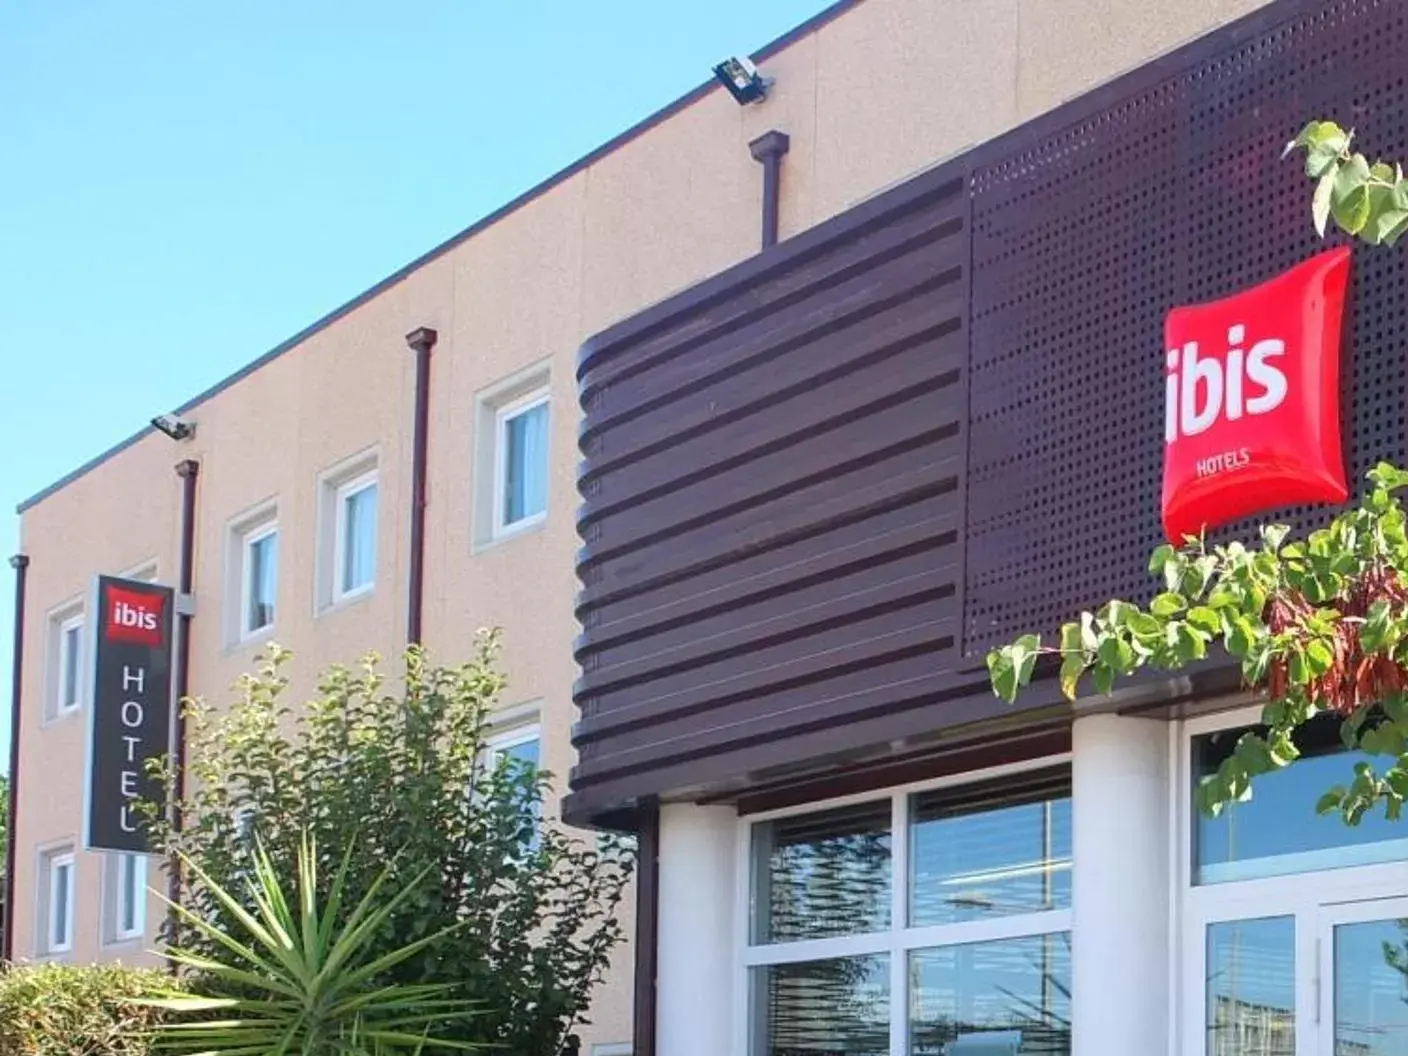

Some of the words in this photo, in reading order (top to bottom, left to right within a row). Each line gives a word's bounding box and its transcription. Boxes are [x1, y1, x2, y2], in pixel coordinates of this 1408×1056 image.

[1165, 324, 1288, 445] ibis
[1196, 447, 1250, 478] HOTELS
[115, 602, 157, 630] ibis
[121, 666, 144, 831] HOTEL
